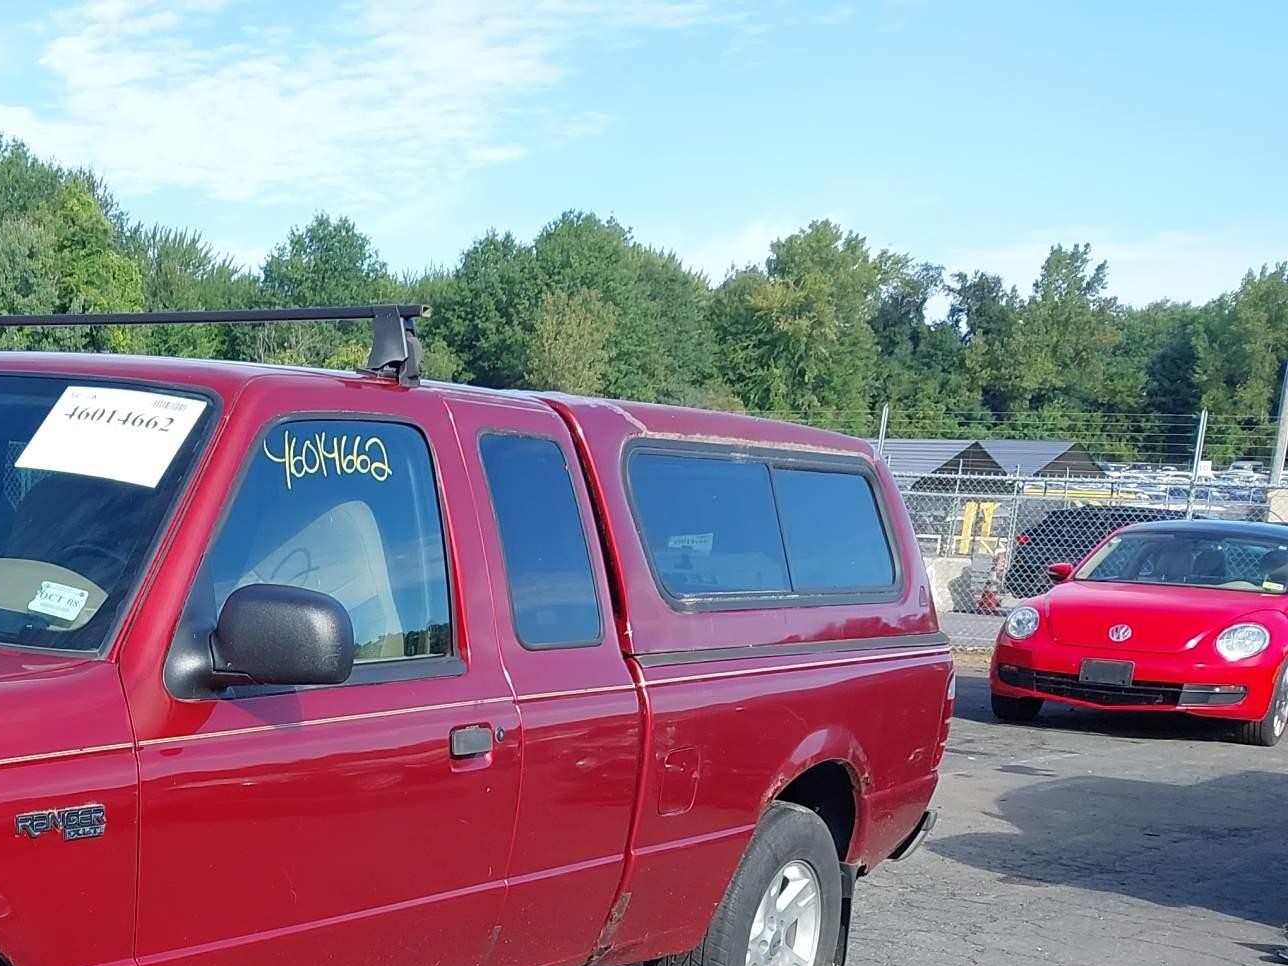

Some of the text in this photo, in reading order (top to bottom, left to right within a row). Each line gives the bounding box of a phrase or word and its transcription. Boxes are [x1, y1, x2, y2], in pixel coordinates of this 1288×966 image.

[64, 405, 175, 432] 46014662
[263, 430, 393, 490] 46014662
[15, 804, 106, 838] RANGER
